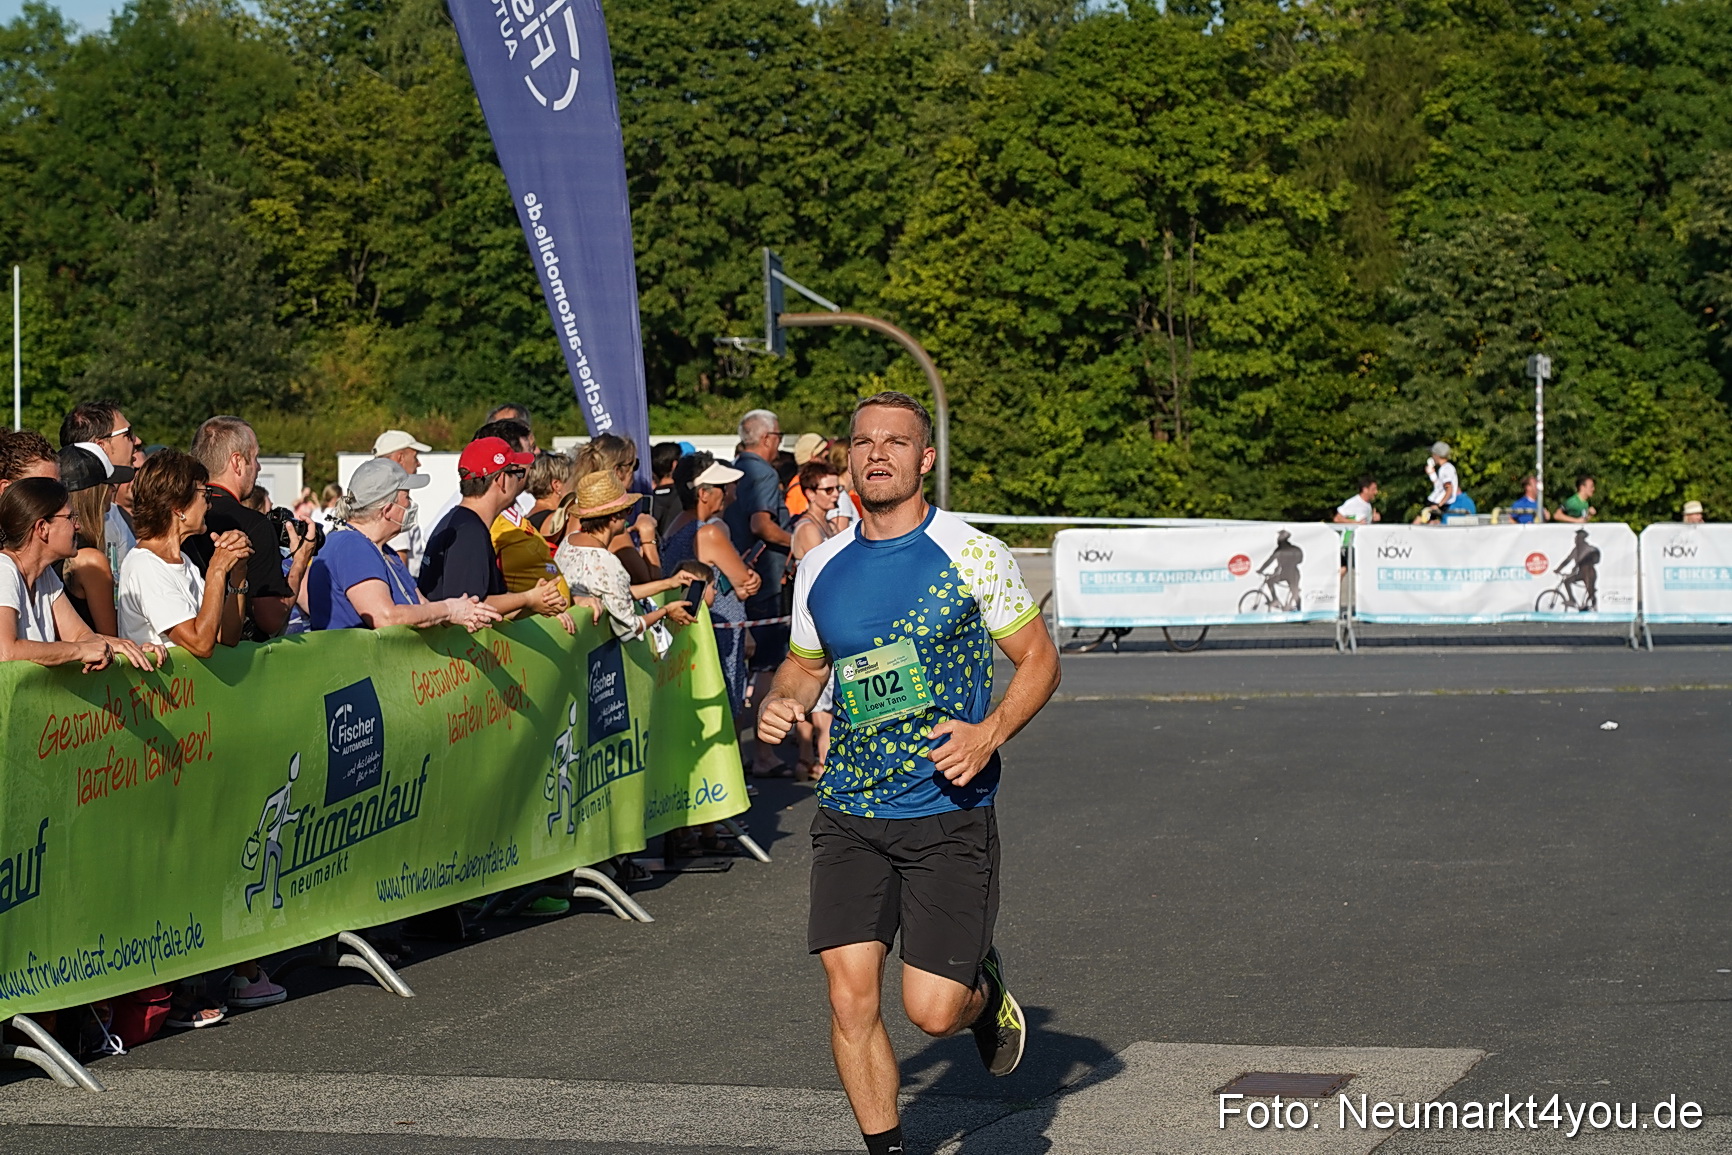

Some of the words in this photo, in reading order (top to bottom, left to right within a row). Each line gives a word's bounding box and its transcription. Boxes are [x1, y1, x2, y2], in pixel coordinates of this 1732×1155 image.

[1078, 549, 1113, 562] NOW
[1377, 546, 1412, 559] NOW
[1663, 545, 1698, 558] NOW
[1081, 571, 1132, 584] E-BIKES
[1379, 568, 1431, 581] E-BIKES
[1665, 567, 1717, 580] E-BIKES
[858, 670, 904, 702] 702
[909, 667, 927, 700] 2022
[128, 677, 195, 726] Firmen
[485, 667, 530, 731] länger!
[846, 690, 860, 715] RUN
[864, 701, 886, 712] Loew
[886, 695, 908, 706] Tano
[338, 716, 376, 746] Fischer
[143, 711, 213, 786] länger!
[341, 735, 374, 756] AUTOMOBILE
[292, 753, 431, 869] firmenlauf
[290, 851, 349, 898] neumarkt
